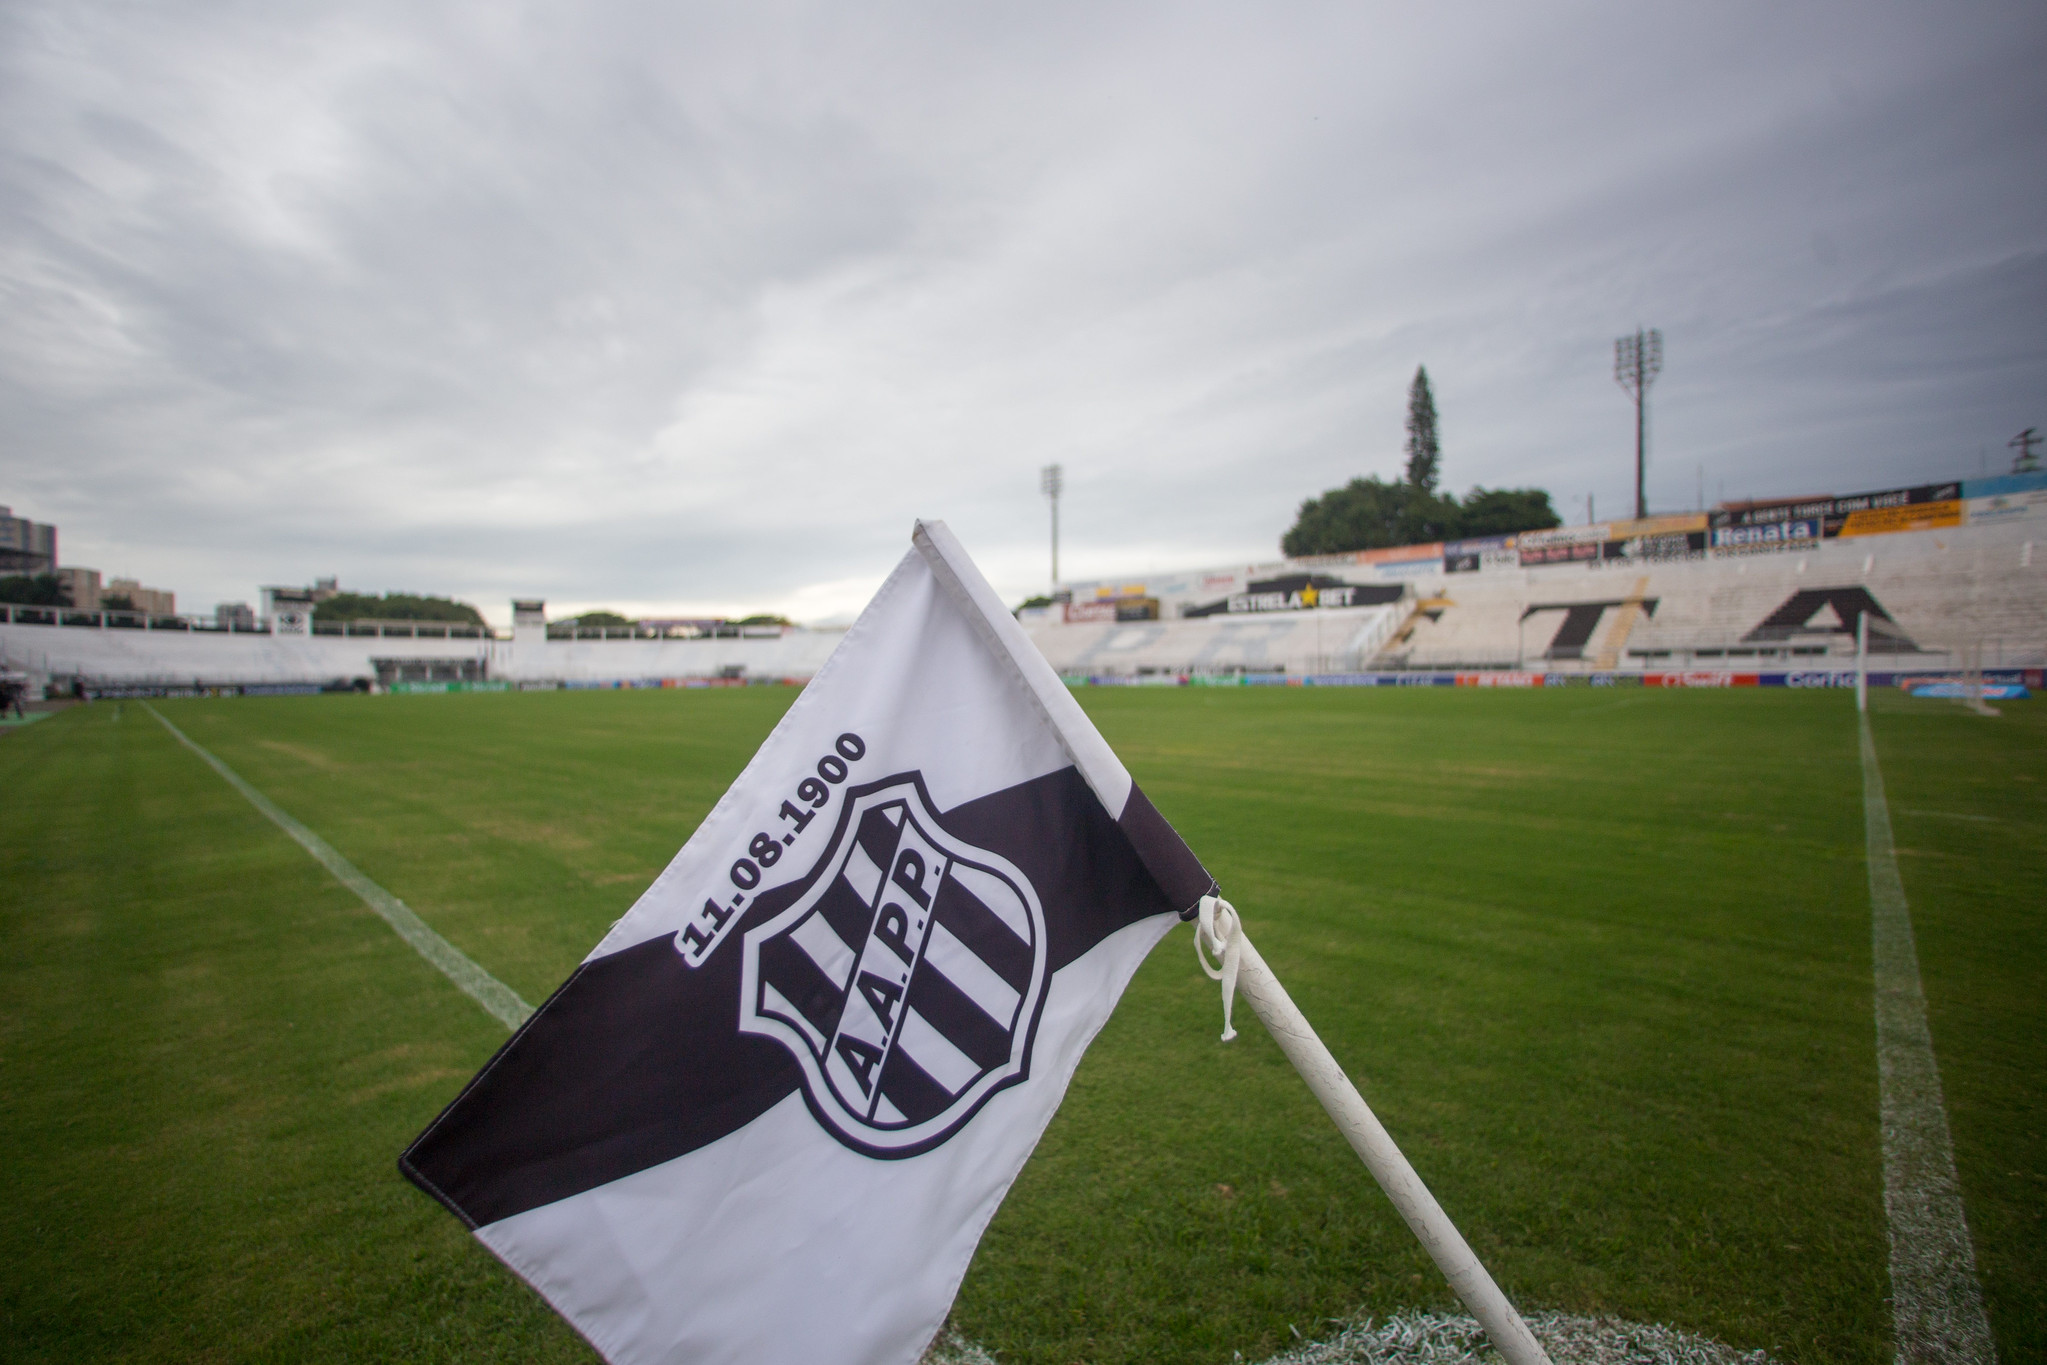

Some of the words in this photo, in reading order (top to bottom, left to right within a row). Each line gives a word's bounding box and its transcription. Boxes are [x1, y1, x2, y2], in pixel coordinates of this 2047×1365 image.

[1716, 520, 1810, 546] Renata
[1228, 590, 1302, 612] ESTRELA
[1319, 587, 1356, 608] BET
[1682, 671, 1733, 688] Swift
[682, 732, 866, 959] 11.08.1900
[835, 847, 942, 1090] A.A.P.P.
